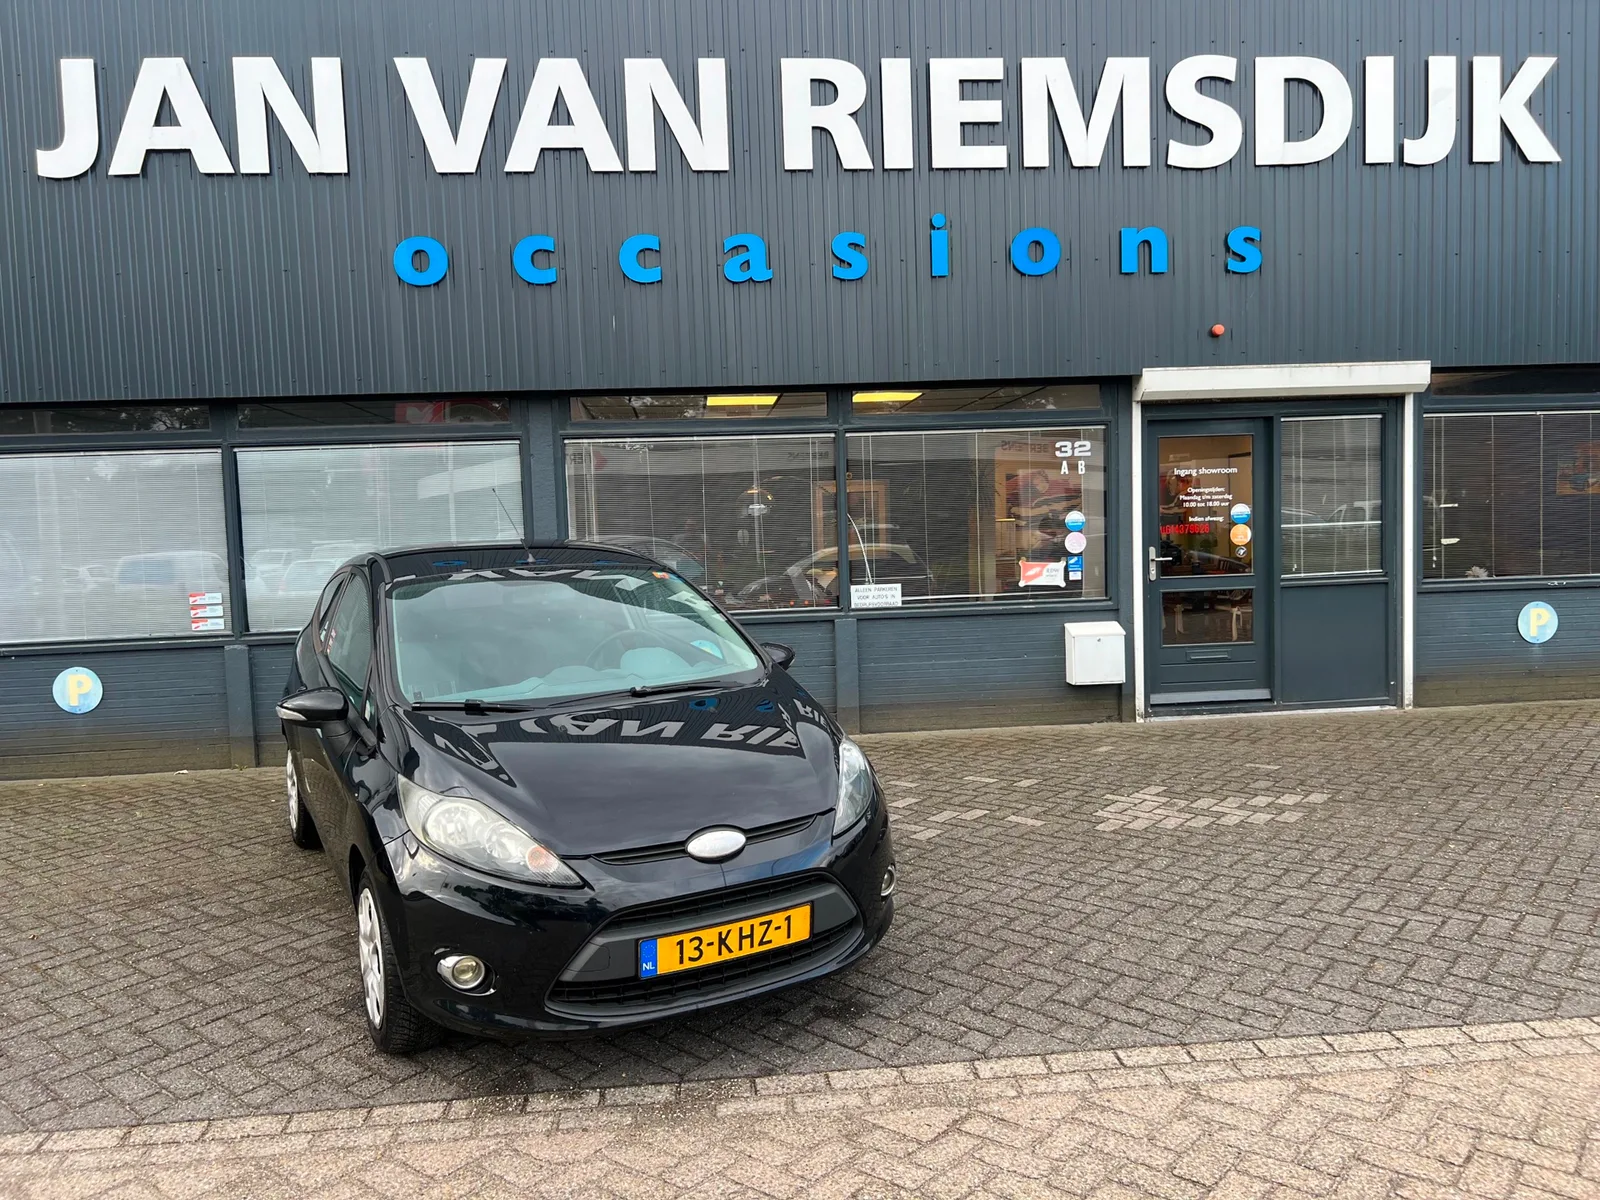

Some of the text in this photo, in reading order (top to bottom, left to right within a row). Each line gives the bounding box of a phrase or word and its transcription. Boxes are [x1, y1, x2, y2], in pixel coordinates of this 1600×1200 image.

[36, 54, 1562, 180] JAN VAN RIEMSDIJK
[393, 213, 1263, 287] occasions
[1055, 440, 1091, 457] 32
[1060, 461, 1086, 474] A B
[1174, 468, 1197, 476] Ingang
[1530, 608, 1551, 637] P
[68, 674, 92, 707] P
[676, 915, 792, 965] 13-KHZ-1
[642, 961, 656, 971] NL
